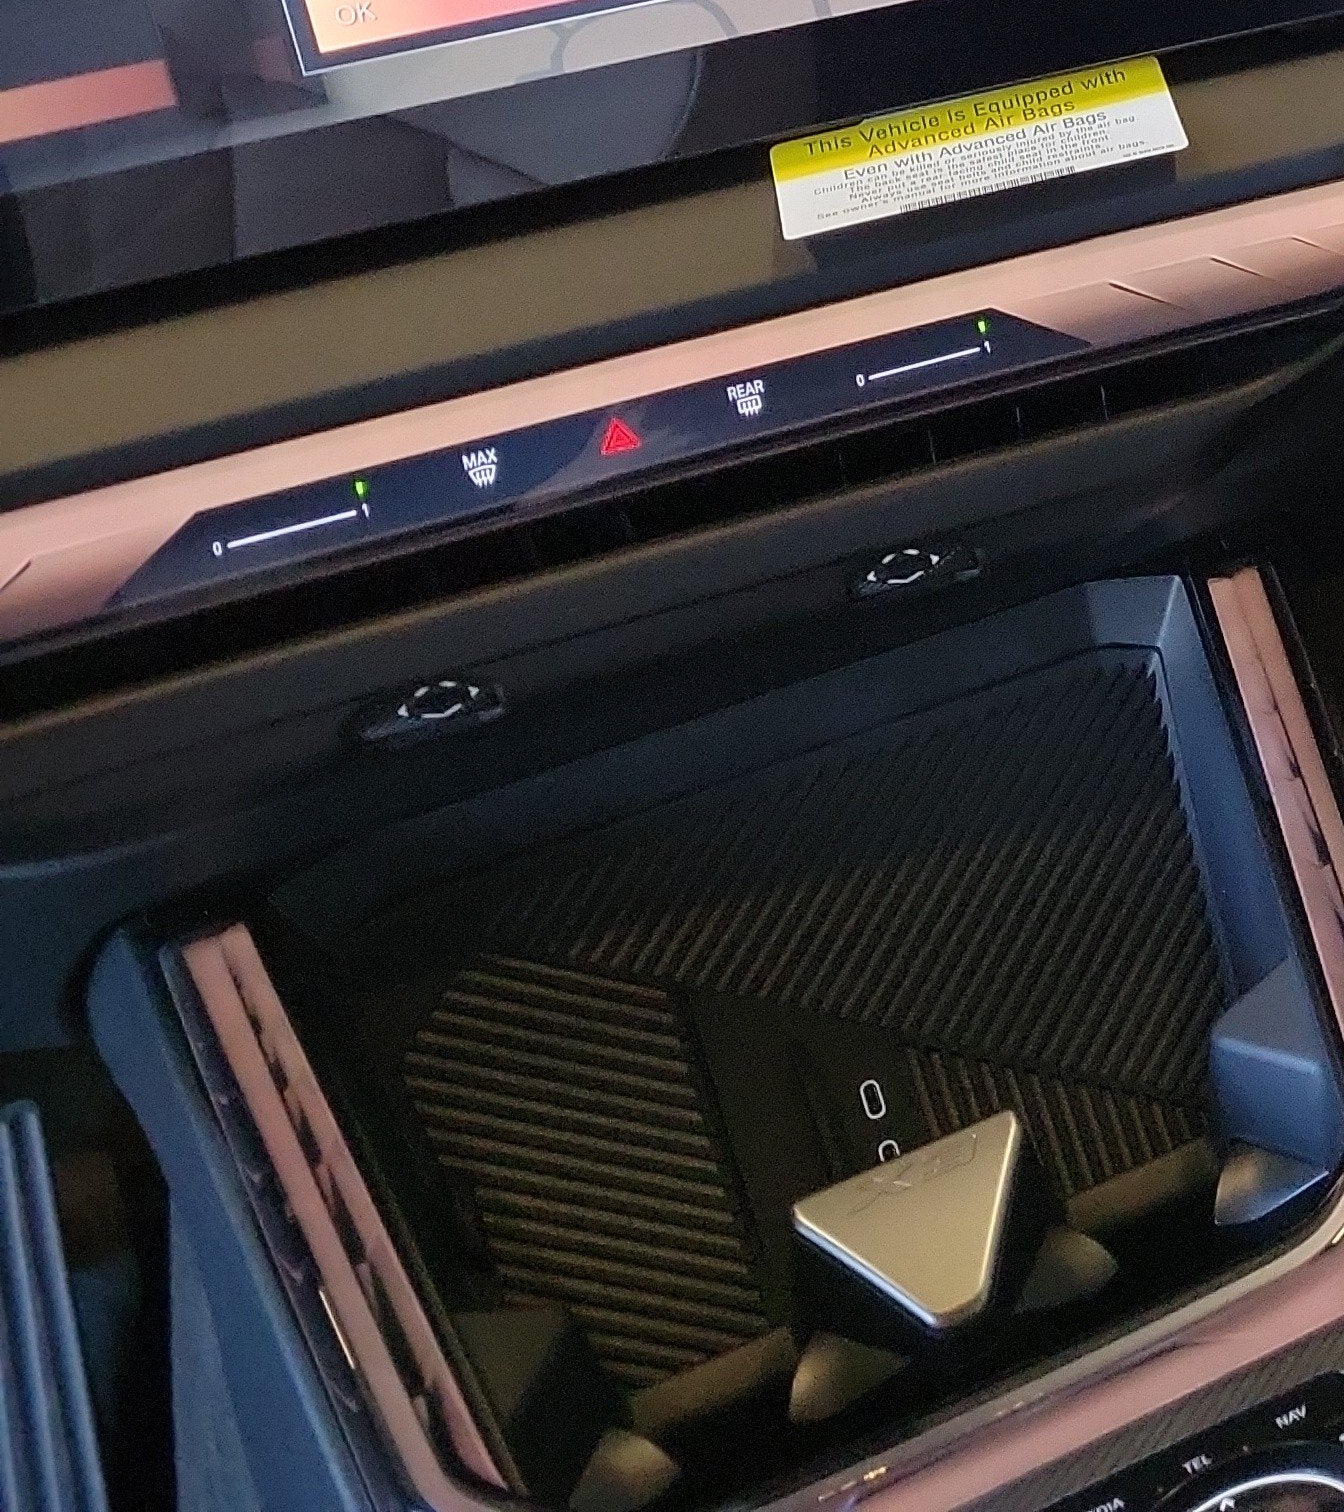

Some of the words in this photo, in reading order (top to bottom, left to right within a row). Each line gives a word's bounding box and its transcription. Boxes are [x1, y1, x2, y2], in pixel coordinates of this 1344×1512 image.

[335, 1, 378, 26] OK
[803, 135, 852, 156] This
[859, 115, 940, 144] Vehicle
[947, 108, 966, 124] is
[974, 81, 1074, 117] Equipped
[1080, 69, 1126, 91] with
[868, 122, 975, 158] Advanced
[984, 114, 1018, 131] Air
[1023, 100, 1075, 122] Bags
[844, 163, 888, 180] Even
[893, 151, 933, 168] with
[939, 128, 1027, 158] Advanced
[1033, 122, 1057, 137] Air
[1063, 111, 1107, 128] Bags
[726, 379, 765, 402] REAR
[855, 373, 865, 387] 0
[462, 447, 498, 471] MAX
[212, 541, 222, 556] 0
[1275, 1404, 1308, 1430] NAV
[1182, 1453, 1213, 1474] TEL
